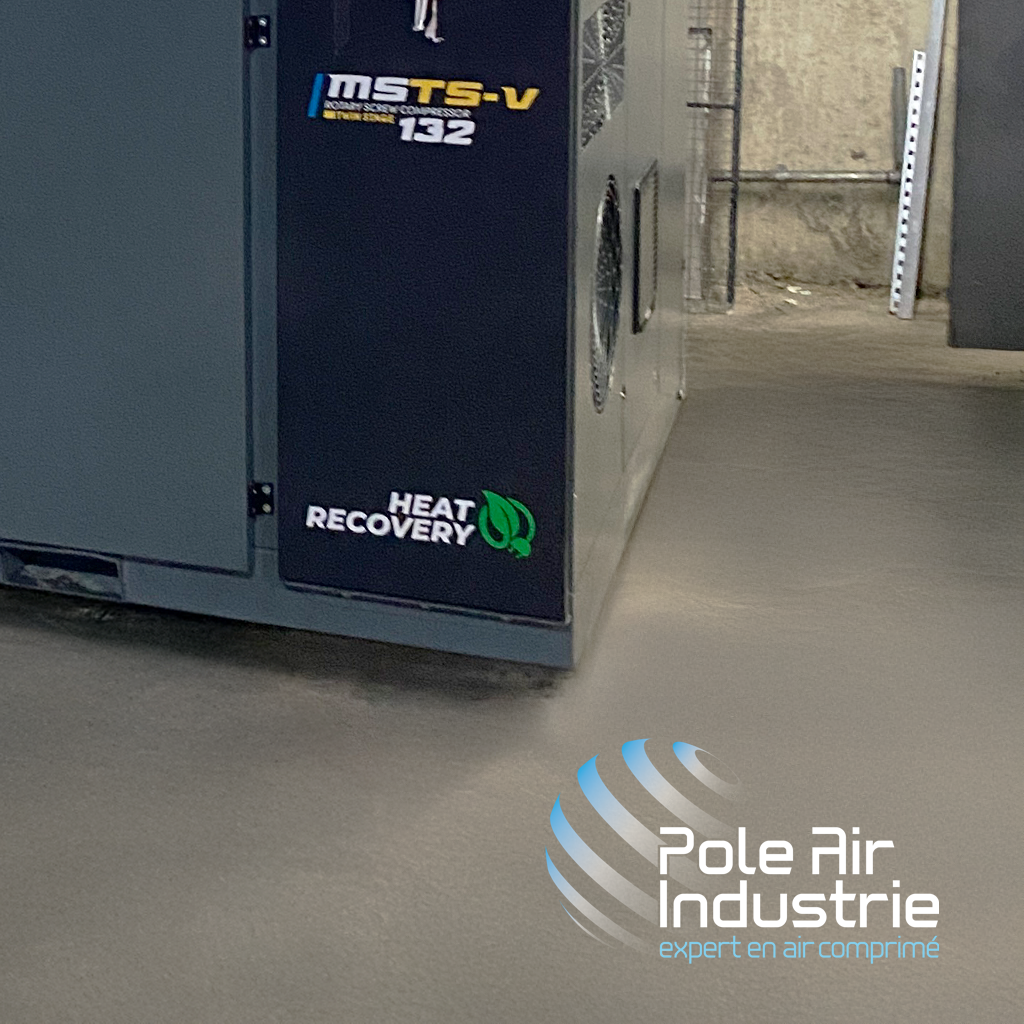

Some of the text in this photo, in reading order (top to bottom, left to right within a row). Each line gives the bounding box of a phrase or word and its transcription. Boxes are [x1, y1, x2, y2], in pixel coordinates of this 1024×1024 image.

[399, 117, 476, 146] 132
[388, 491, 476, 522] HEAT
[305, 504, 476, 546] RECOVERY
